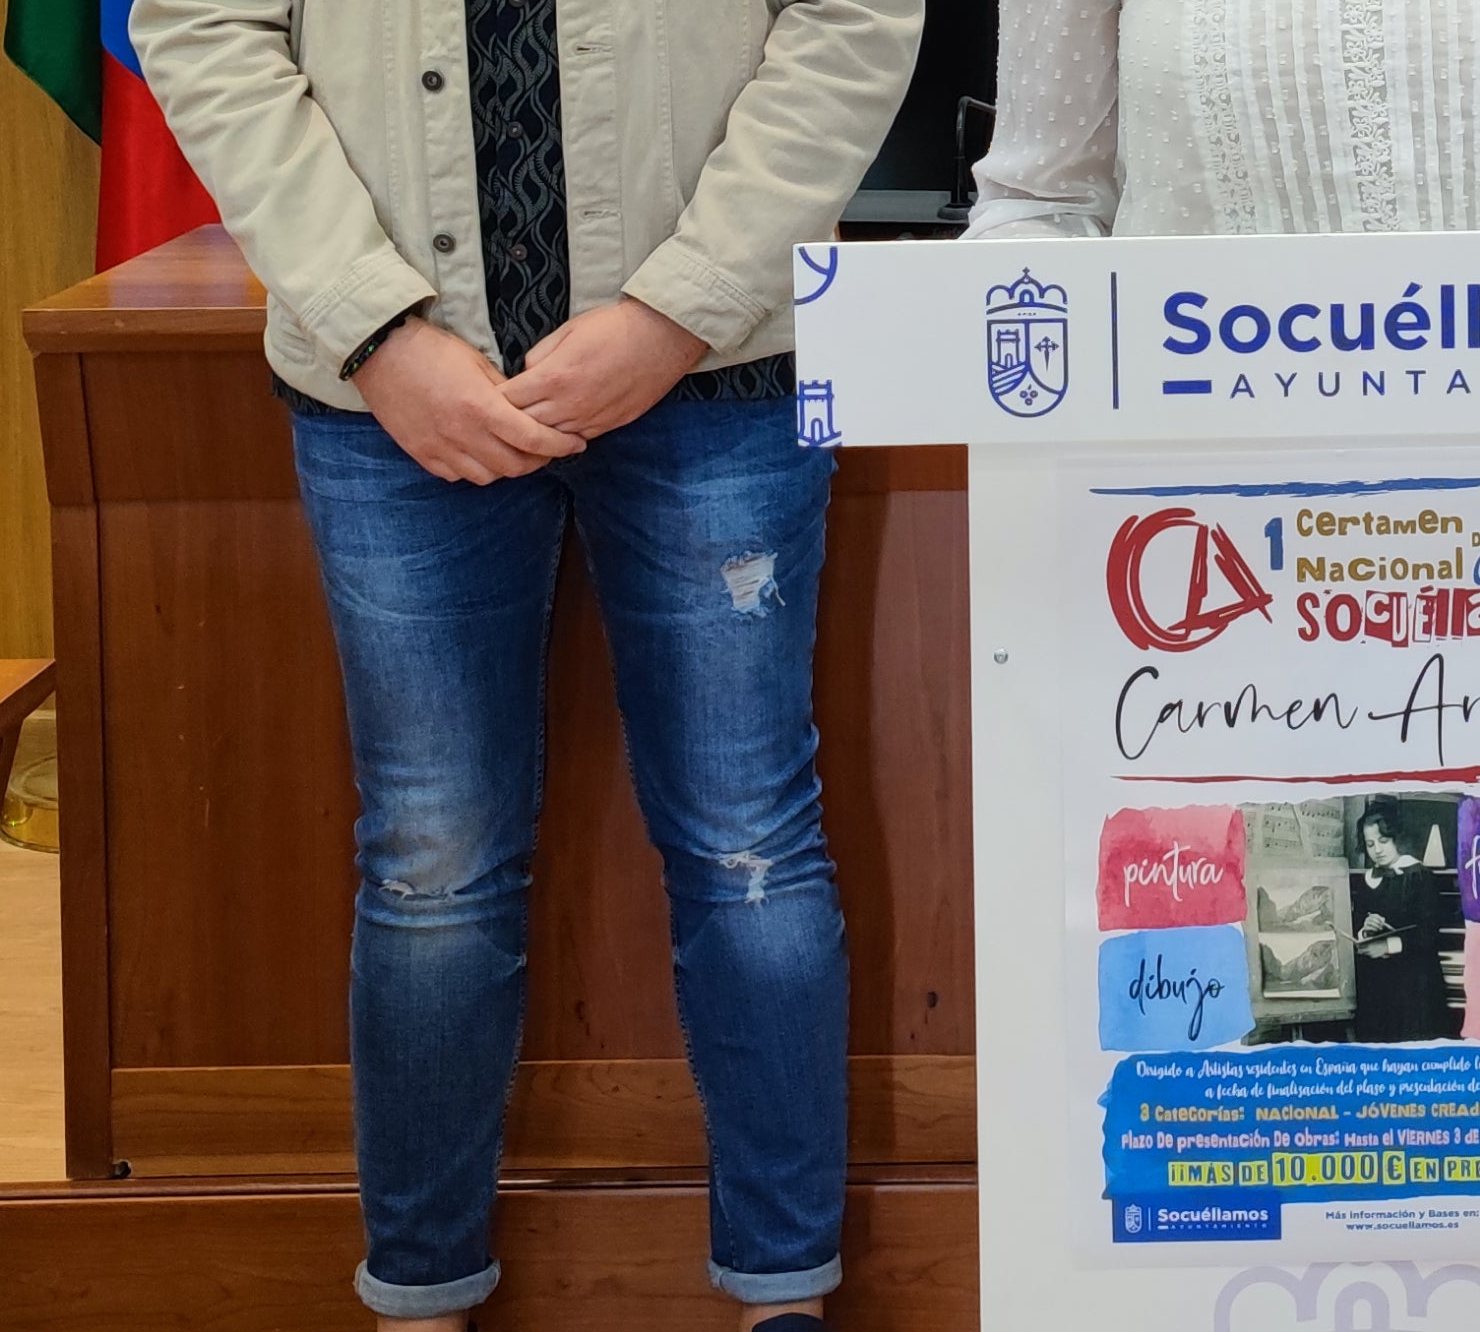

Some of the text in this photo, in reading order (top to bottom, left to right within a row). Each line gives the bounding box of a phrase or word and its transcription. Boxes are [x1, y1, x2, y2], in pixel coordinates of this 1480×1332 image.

[1264, 516, 1284, 571] 1
[1114, 665, 1360, 761] Carmen
[1123, 840, 1224, 908] pintura
[1128, 954, 1225, 1042] dibujo
[1136, 1060, 1182, 1080] Dirigido
[1185, 1066, 1196, 1079] a
[1197, 1059, 1243, 1079] Artistas
[1246, 1059, 1297, 1077] residentes
[1300, 1064, 1313, 1075] en
[1315, 1057, 1357, 1077] España
[1360, 1062, 1379, 1076] que
[1382, 1058, 1419, 1076] hayan
[1421, 1055, 1471, 1074] cumplido
[1216, 1082, 1248, 1100] fecha
[1250, 1081, 1265, 1098] de
[1336, 1078, 1354, 1096] del
[1388, 1083, 1397, 1098] y
[1399, 1077, 1465, 1097] presentación
[1467, 1077, 1480, 1093] de
[1121, 1129, 1154, 1150] Plazo
[1343, 1131, 1379, 1147] Hasta
[1382, 1127, 1394, 1146] el
[1241, 1164, 1265, 1182] DE
[1275, 1154, 1375, 1181] 10.000
[1387, 1155, 1402, 1180] €
[1413, 1160, 1437, 1180] EN
[1157, 1207, 1269, 1222] Socuéllamos
[1325, 1209, 1480, 1219] Más información y Bases en:
[1346, 1220, 1459, 1230] www.socuellamos.es
